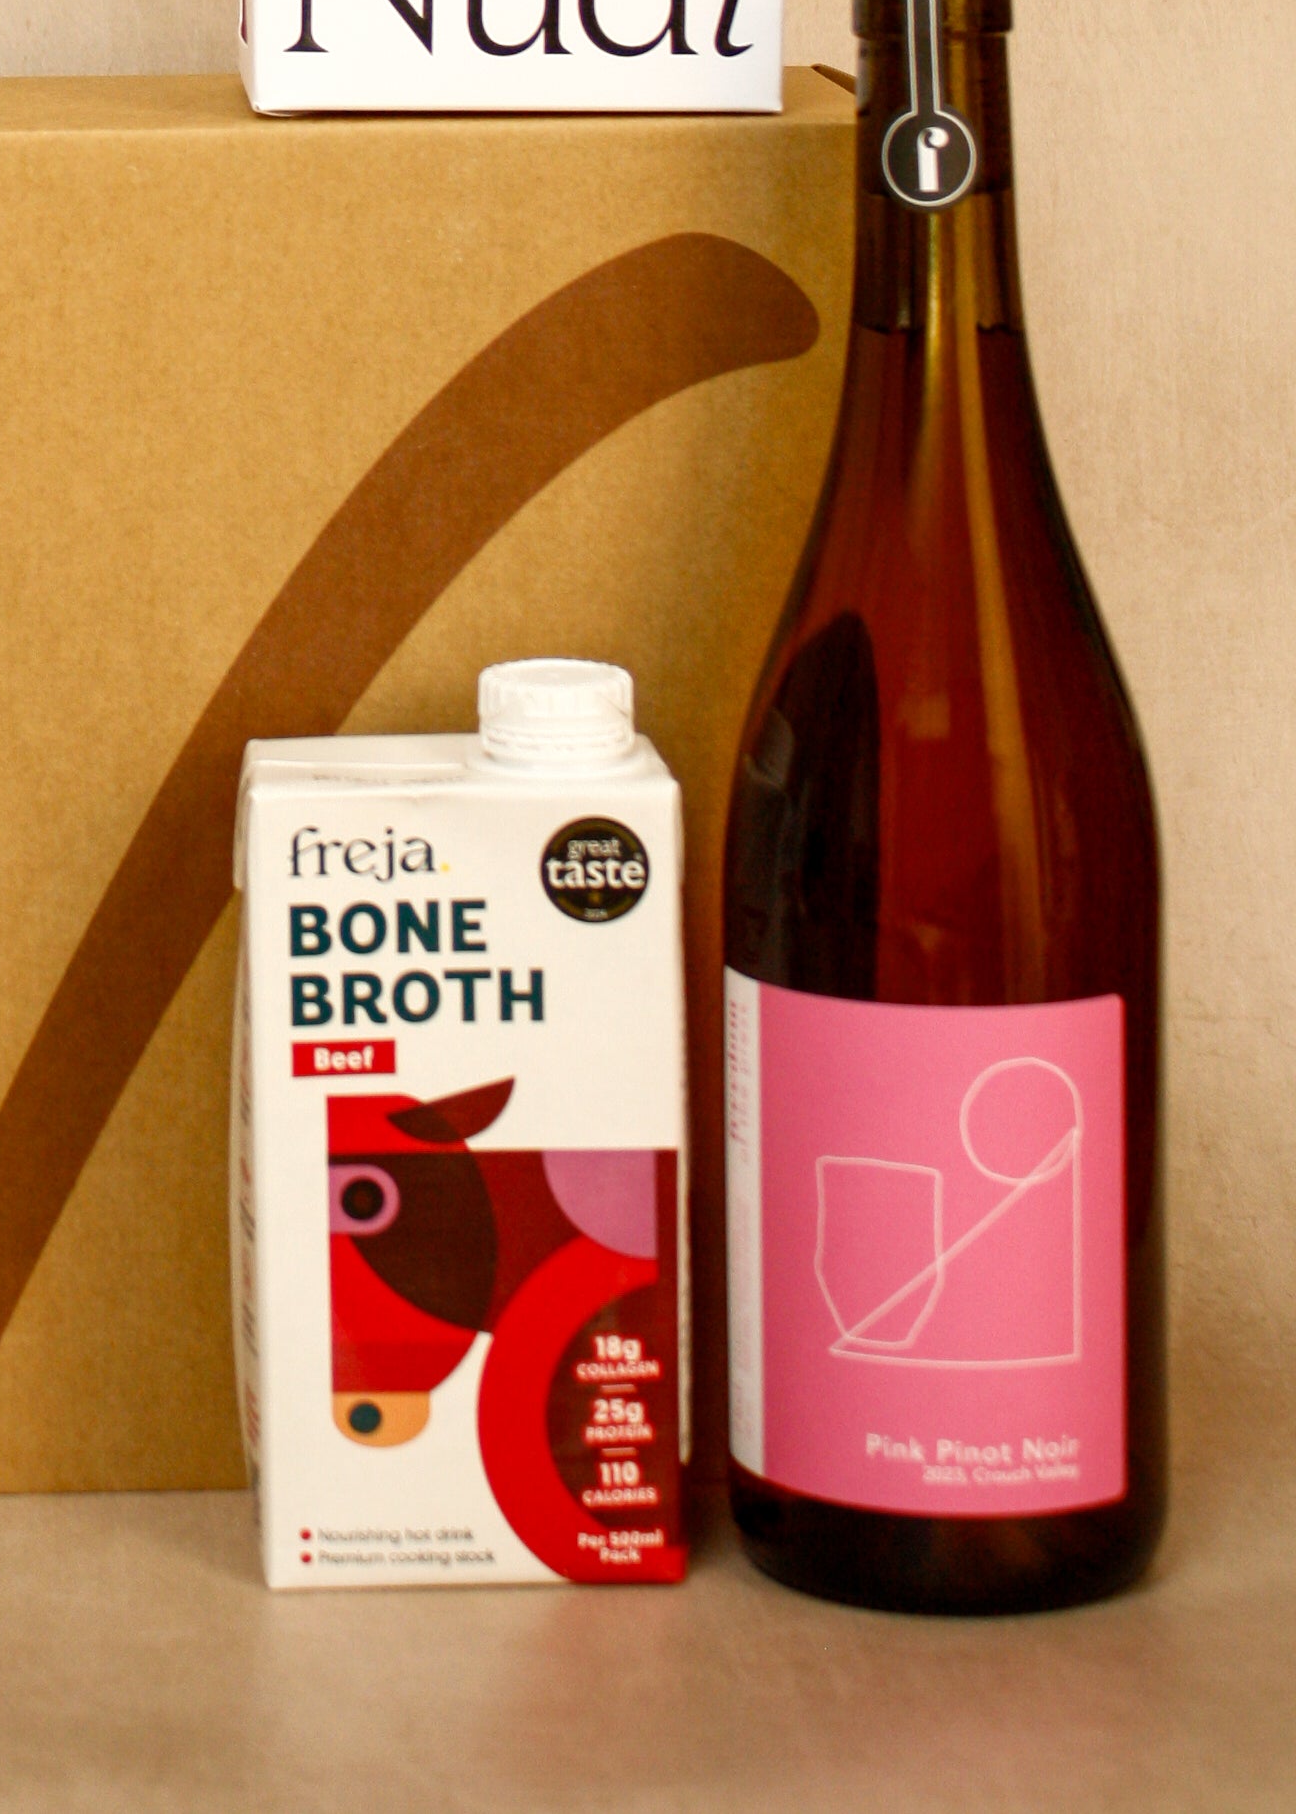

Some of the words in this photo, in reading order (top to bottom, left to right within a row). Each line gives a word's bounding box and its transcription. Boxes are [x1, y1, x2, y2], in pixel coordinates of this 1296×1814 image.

[567, 838, 621, 861] great
[546, 858, 646, 889] taste
[289, 899, 487, 957] BONE
[290, 968, 544, 1027] BROTH
[313, 1046, 375, 1071] Beef
[594, 1335, 642, 1362] 18g
[593, 1398, 644, 1425] 25g
[865, 1433, 925, 1462] Pink
[936, 1438, 1013, 1466] Pinot
[1022, 1435, 1080, 1462] Noir
[599, 1460, 640, 1487] 110
[582, 1487, 658, 1507] CALORIES
